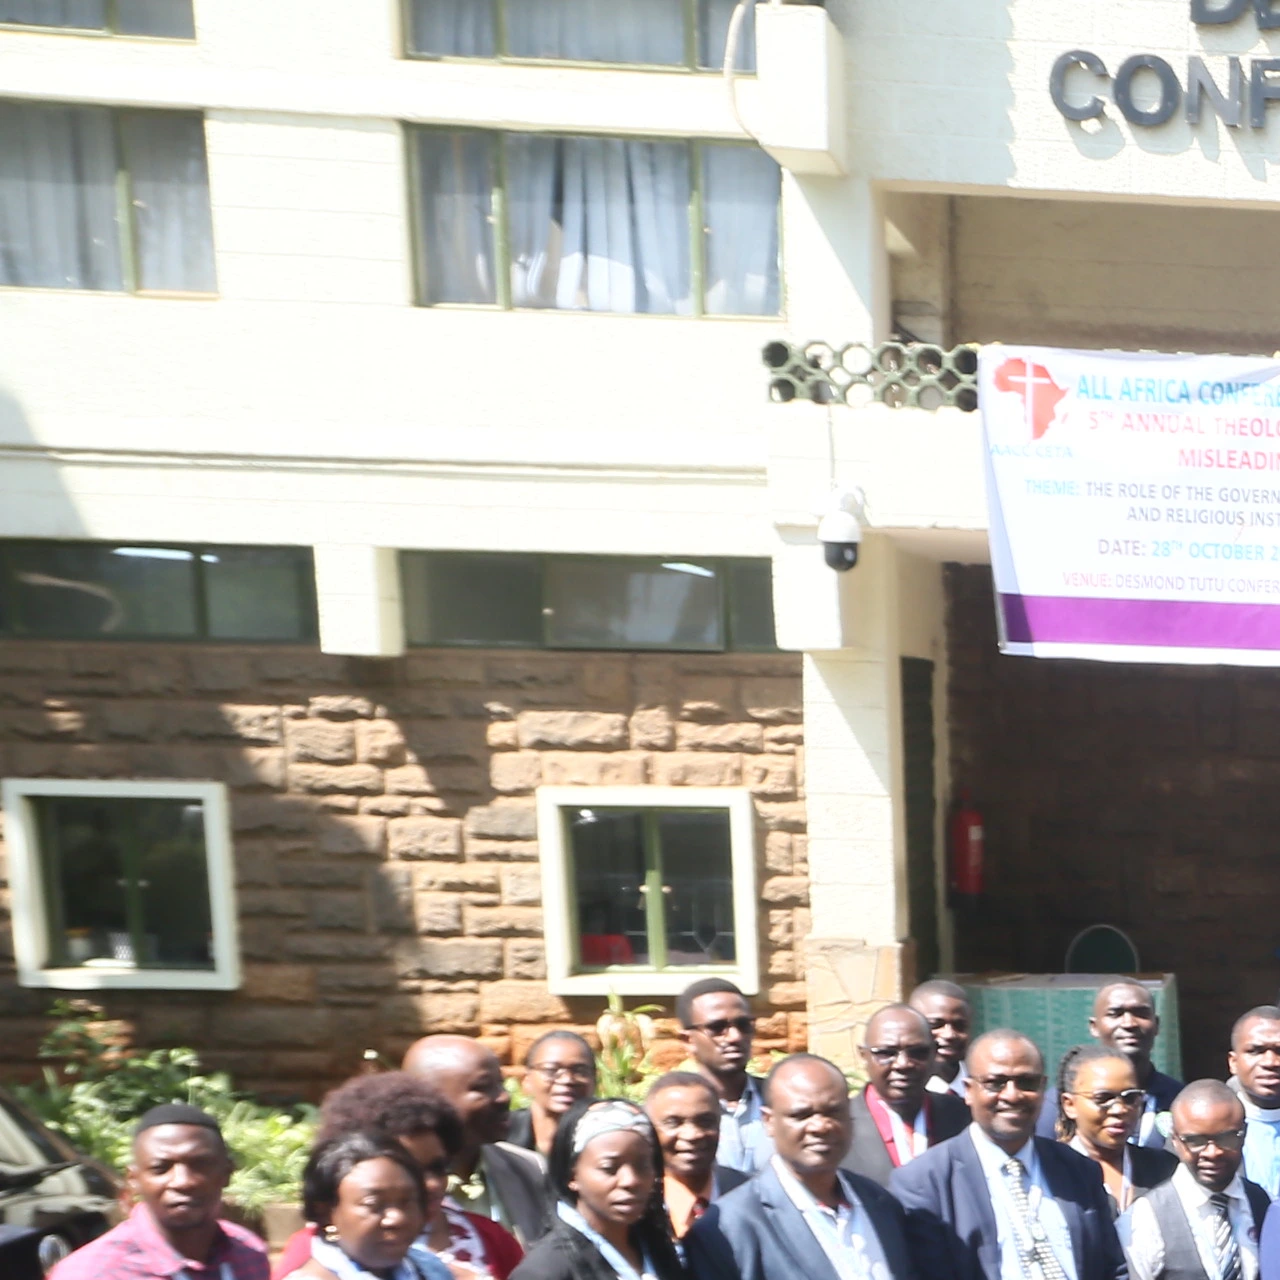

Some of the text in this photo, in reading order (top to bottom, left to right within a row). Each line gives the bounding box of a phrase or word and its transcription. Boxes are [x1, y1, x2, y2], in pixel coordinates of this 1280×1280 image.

[1077, 374, 1112, 400] ALL
[1119, 376, 1192, 404] AFRICA
[1121, 412, 1205, 435] ANNUAL
[1086, 481, 1112, 498] THE
[1118, 482, 1156, 499] ROLE
[1161, 484, 1181, 500] OF
[1186, 486, 1213, 502] THE
[1127, 506, 1161, 522] AND
[1166, 507, 1245, 526] RELIGIOUS
[1098, 539, 1146, 557] DATE:
[1188, 542, 1264, 561] OCTOBER
[1062, 571, 1112, 588] VENUE:
[1115, 573, 1185, 591] DESMOND
[1188, 576, 1224, 592] TUTU
